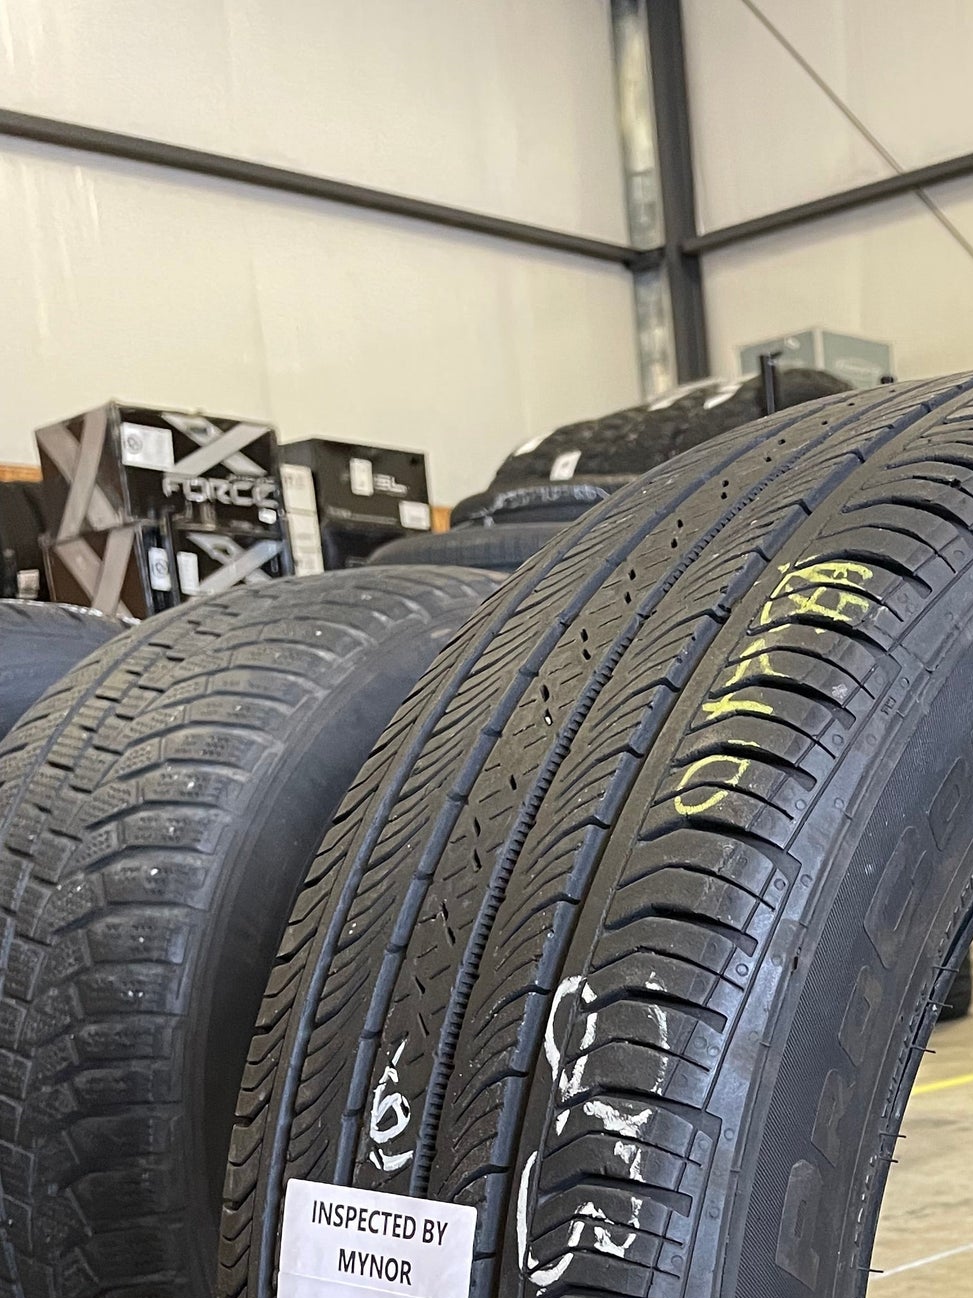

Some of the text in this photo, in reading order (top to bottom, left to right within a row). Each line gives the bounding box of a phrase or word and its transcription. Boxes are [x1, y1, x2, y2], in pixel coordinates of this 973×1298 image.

[162, 474, 280, 510] FORCE
[311, 1200, 449, 1246] INSPECTED BY
[337, 1248, 413, 1286] MYNOR
